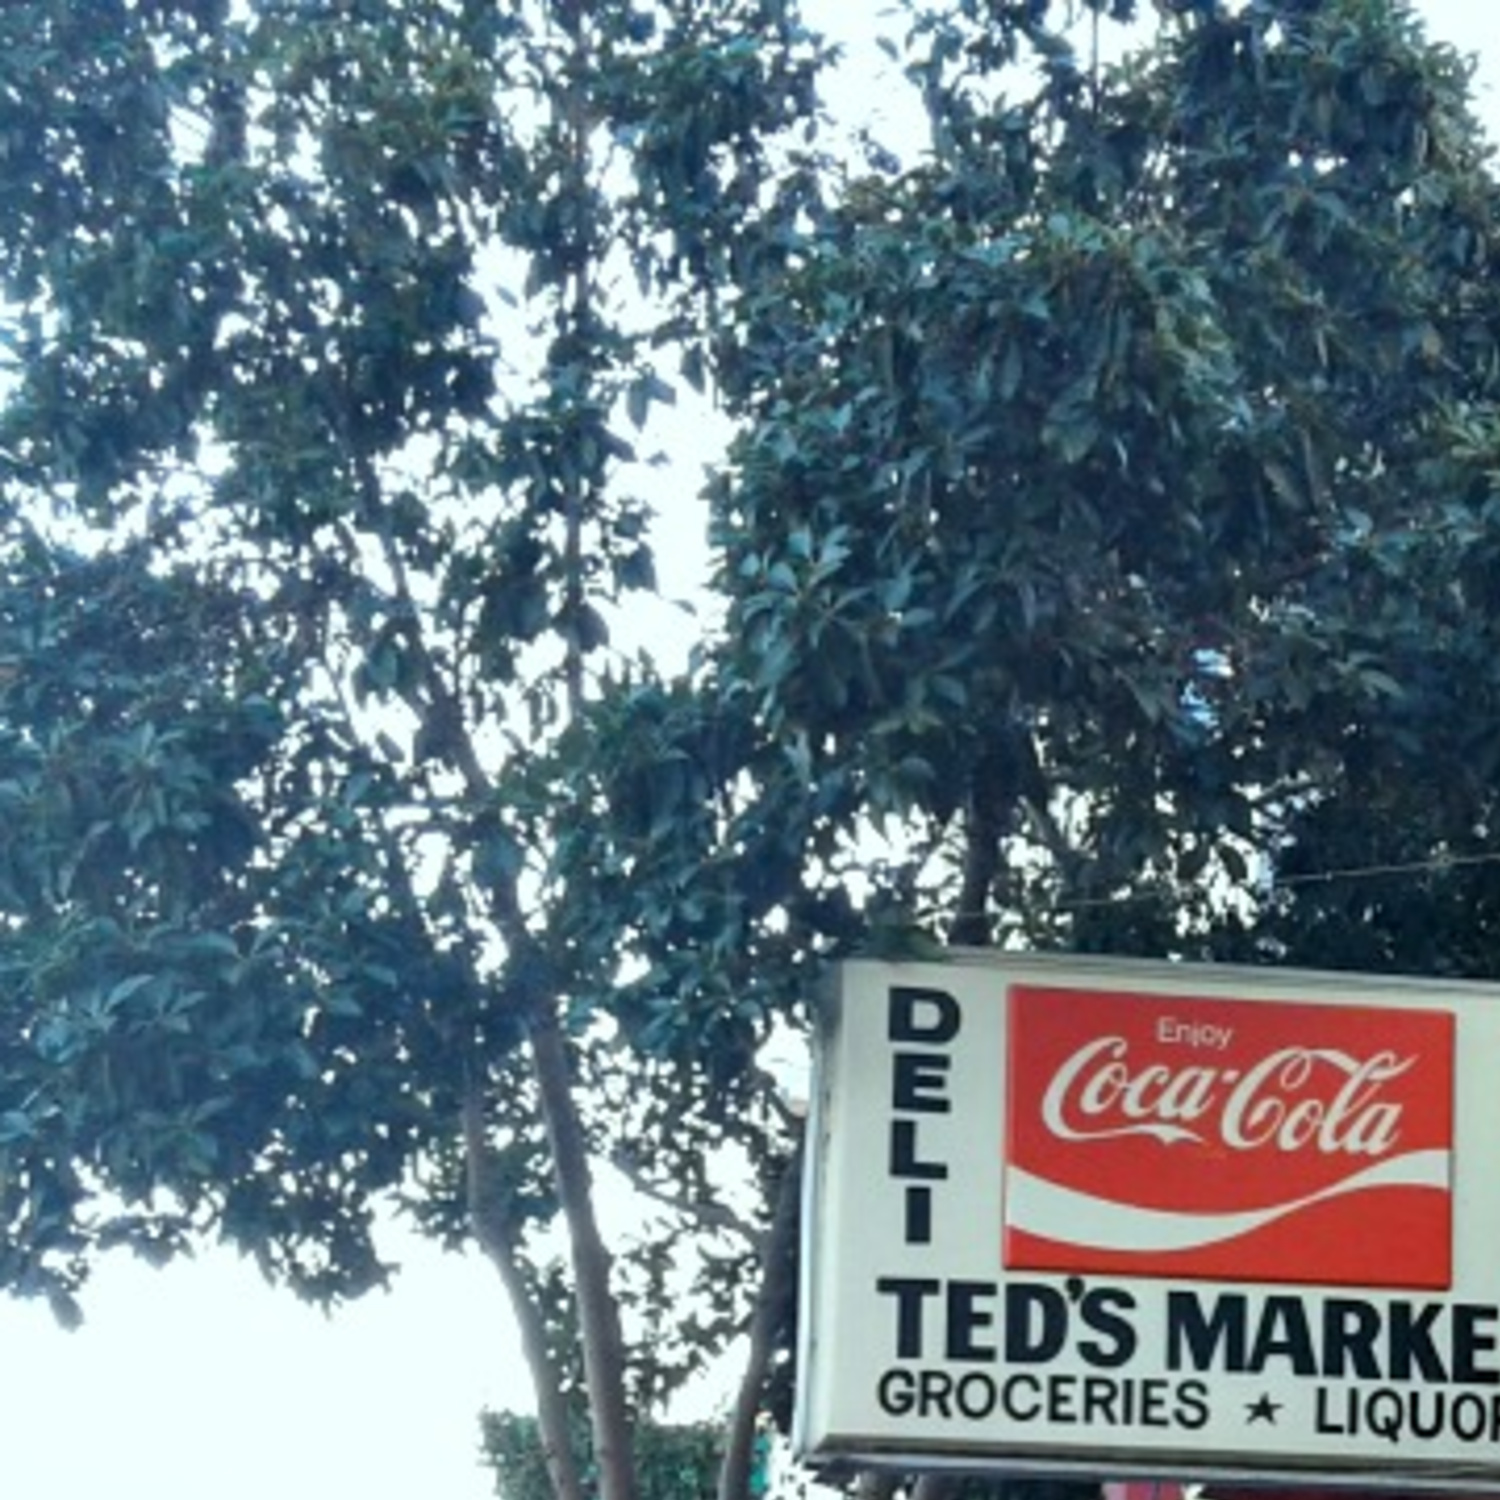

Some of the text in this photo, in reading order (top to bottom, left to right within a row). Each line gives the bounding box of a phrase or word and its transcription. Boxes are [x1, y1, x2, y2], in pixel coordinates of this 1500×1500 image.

[1156, 1017, 1233, 1048] Enjoy
[888, 985, 962, 1245] DELI
[1041, 1036, 1420, 1155] Coca-Cola
[876, 1273, 1138, 1365] TED'S
[876, 1369, 1211, 1428] GROCERIES
